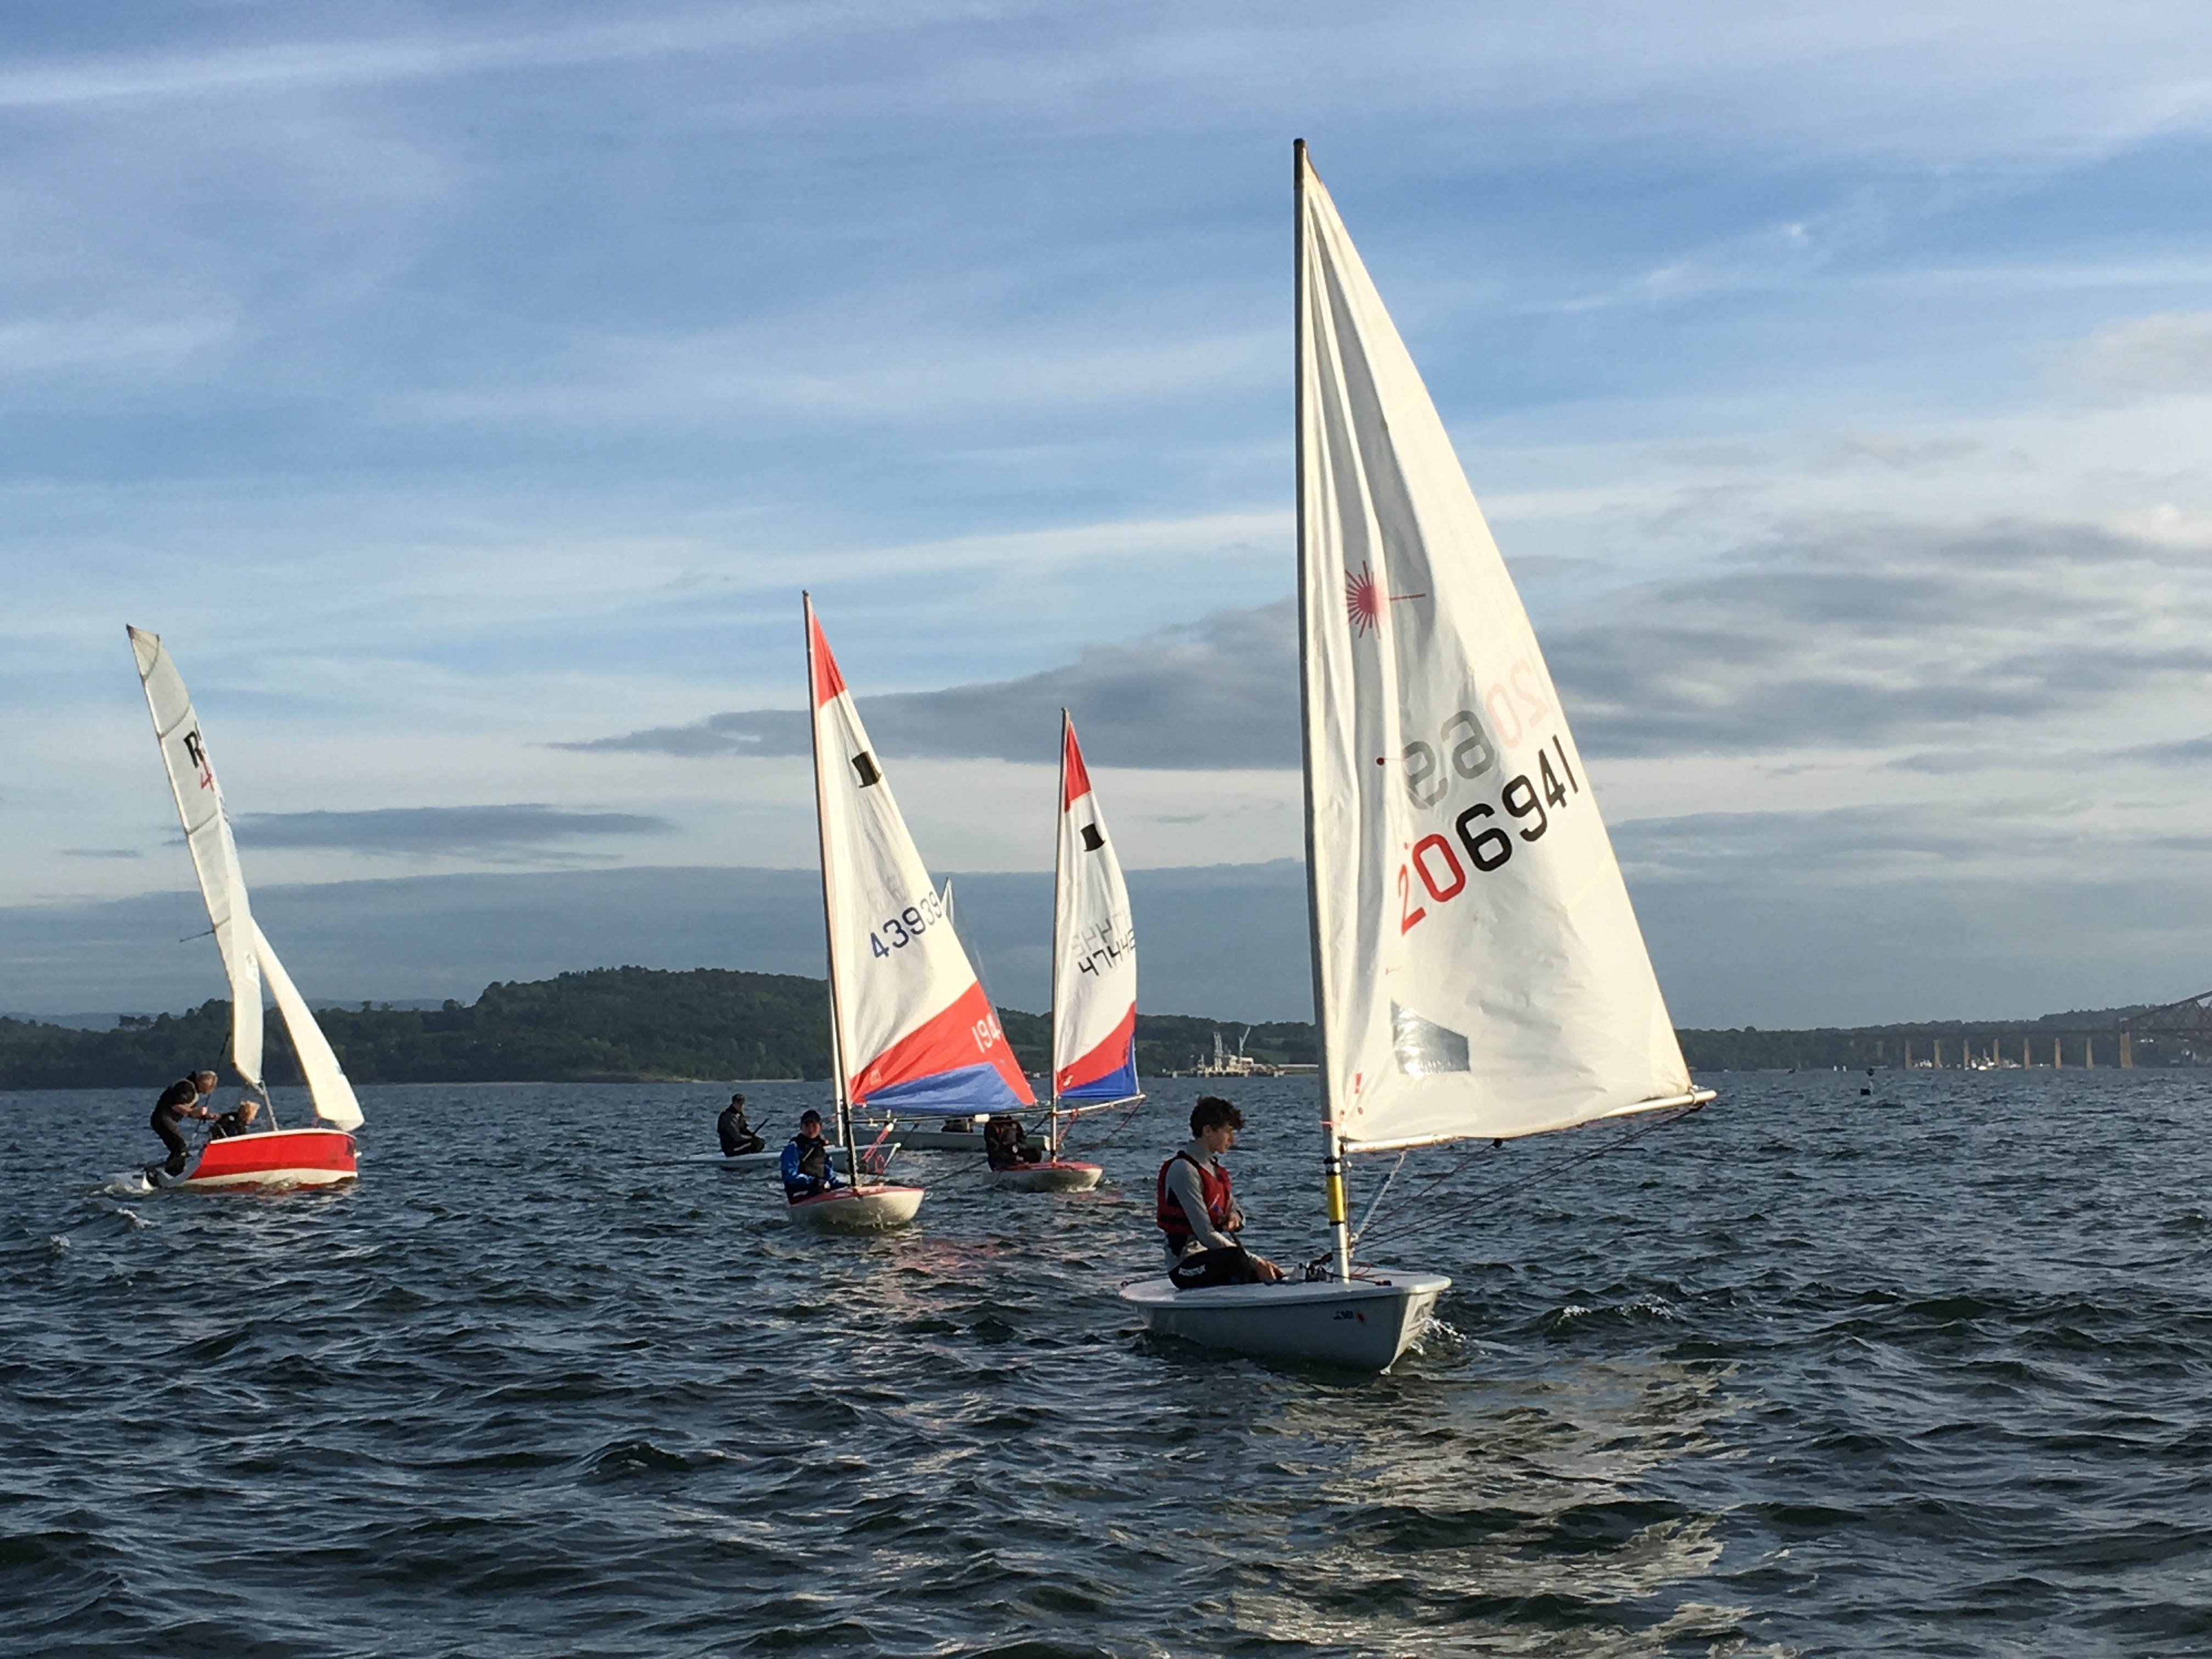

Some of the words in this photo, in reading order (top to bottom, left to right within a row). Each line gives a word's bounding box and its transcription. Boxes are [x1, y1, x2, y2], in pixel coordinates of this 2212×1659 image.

[183, 730, 204, 769] R
[1397, 734, 1578, 937] 206941
[871, 890, 943, 958] 43939
[970, 1012, 1001, 1054] 194
